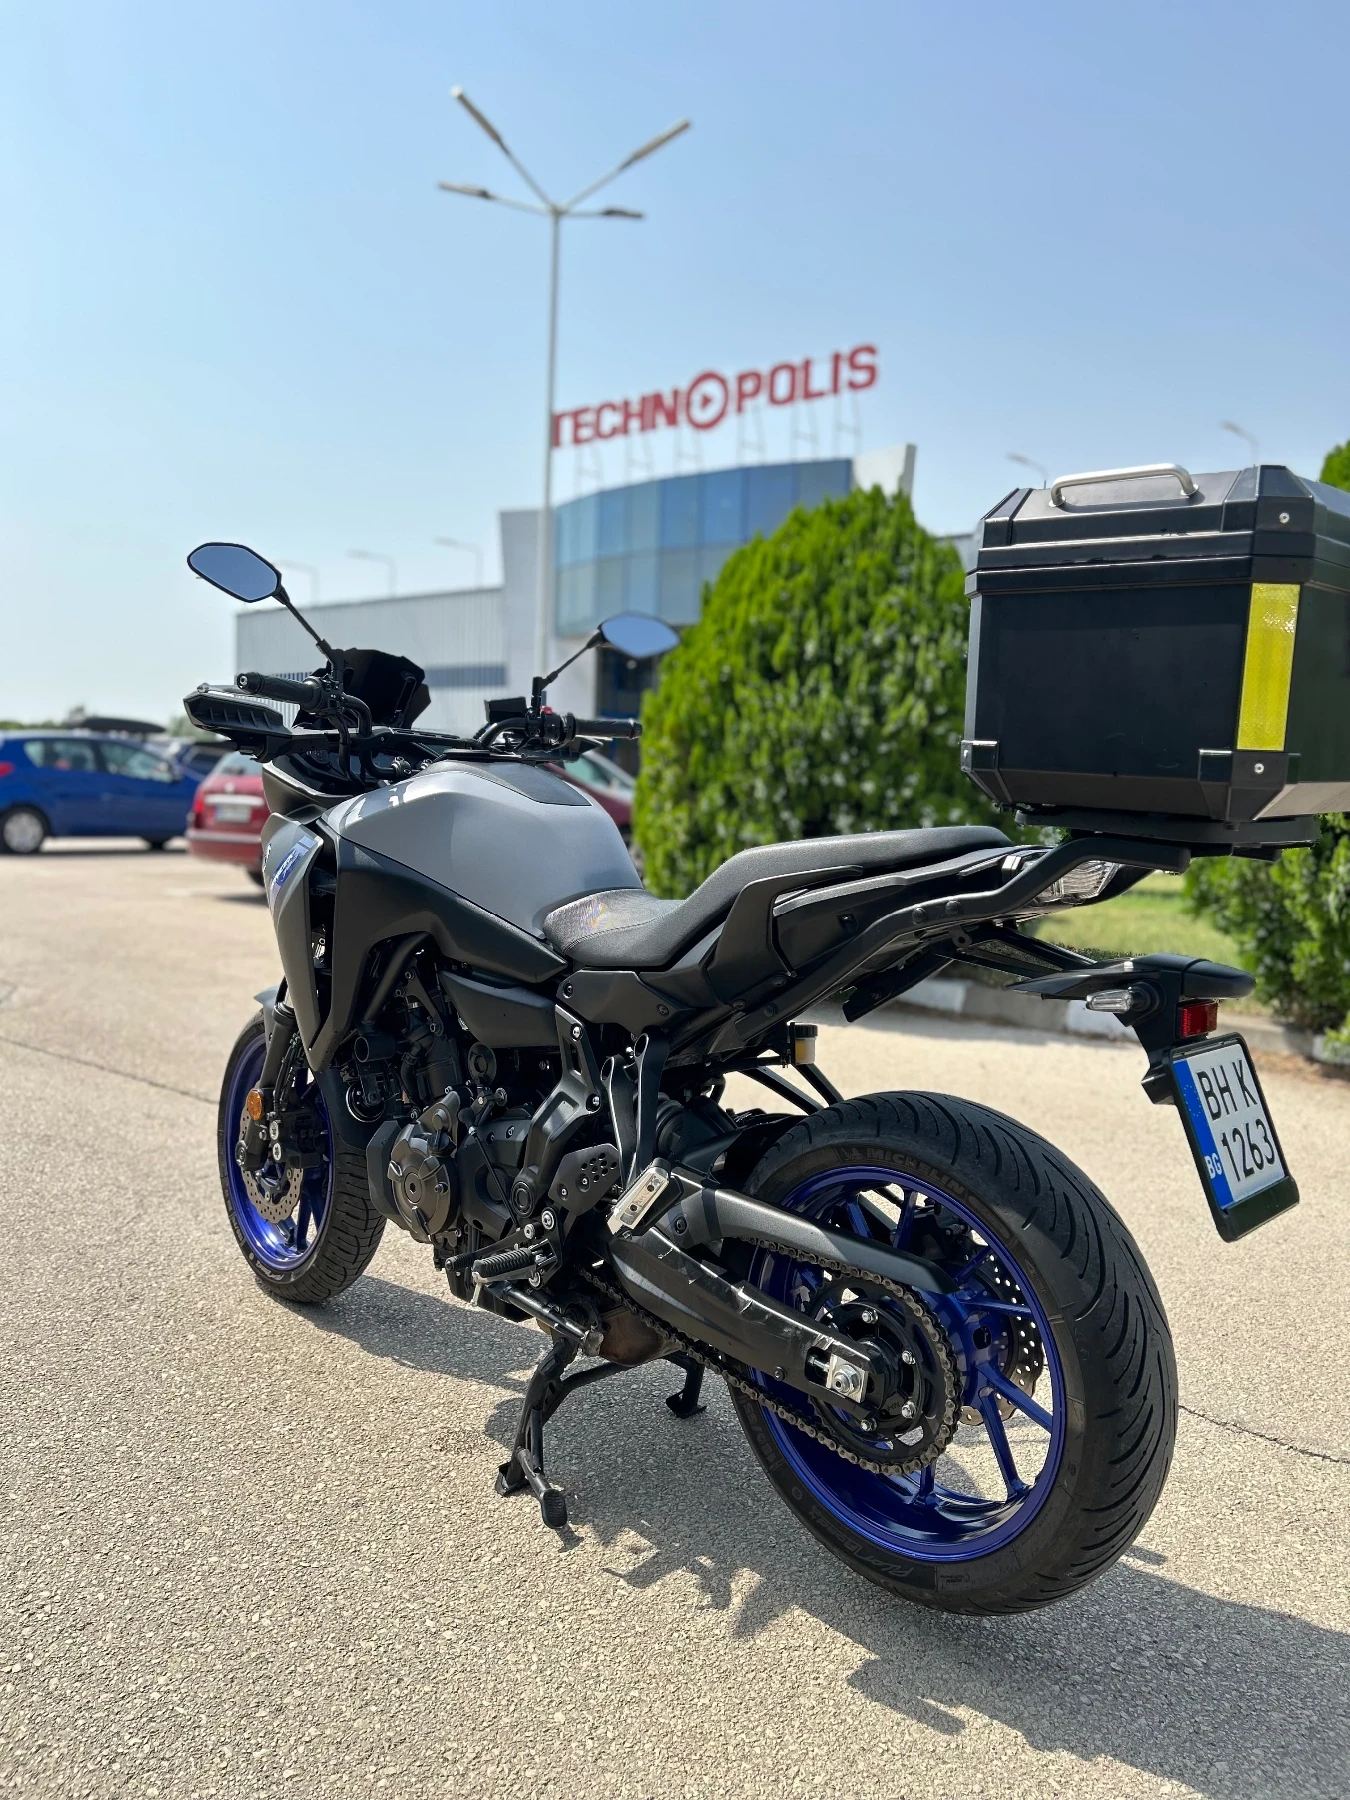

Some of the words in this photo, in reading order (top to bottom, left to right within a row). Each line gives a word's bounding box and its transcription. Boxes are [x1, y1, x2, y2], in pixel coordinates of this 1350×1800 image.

[551, 344, 877, 448] TECHNOPOLIS
[1197, 1065, 1238, 1120] BH
[1232, 1059, 1257, 1107] K
[866, 1147, 966, 1194] MICHELIN
[1204, 1152, 1223, 1180] BG
[1221, 1117, 1275, 1182] 1263
